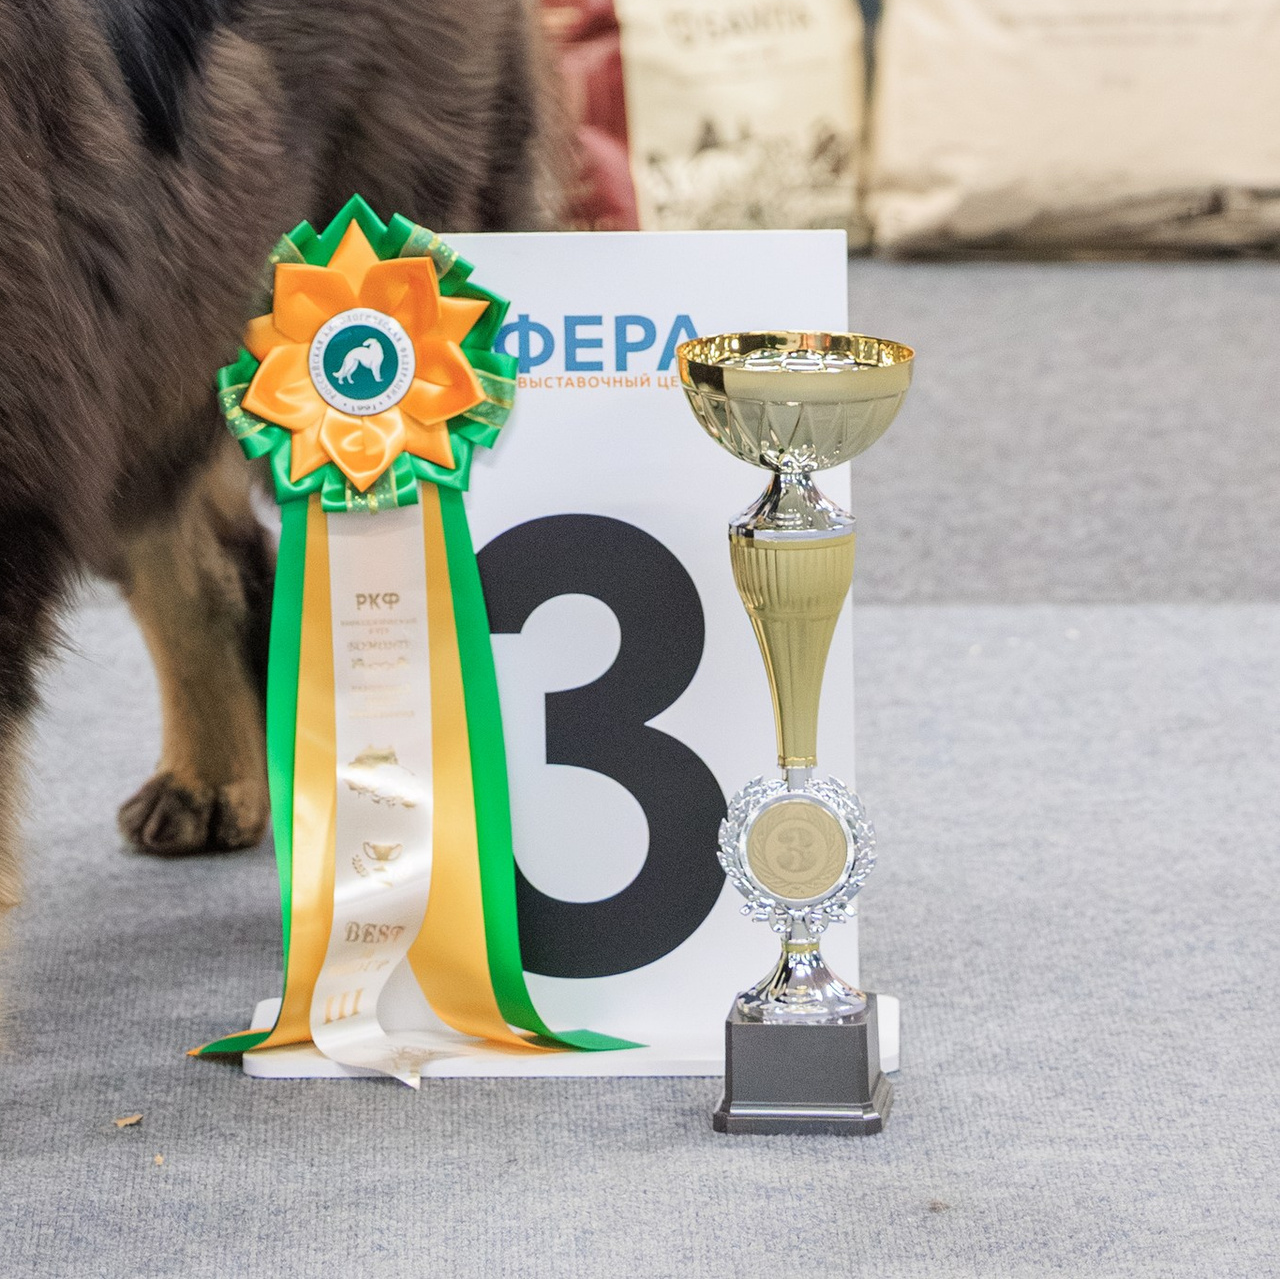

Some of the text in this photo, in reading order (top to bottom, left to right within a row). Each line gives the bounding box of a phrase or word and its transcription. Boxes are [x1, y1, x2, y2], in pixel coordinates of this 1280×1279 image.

[494, 313, 699, 374] ФЕРА
[517, 373, 680, 390] ВЫСТАВОЧНЫЙ ЦЕ
[355, 591, 401, 611] РКФ
[475, 513, 729, 979] 3
[344, 920, 406, 944] BEST
[323, 986, 365, 1025] III
